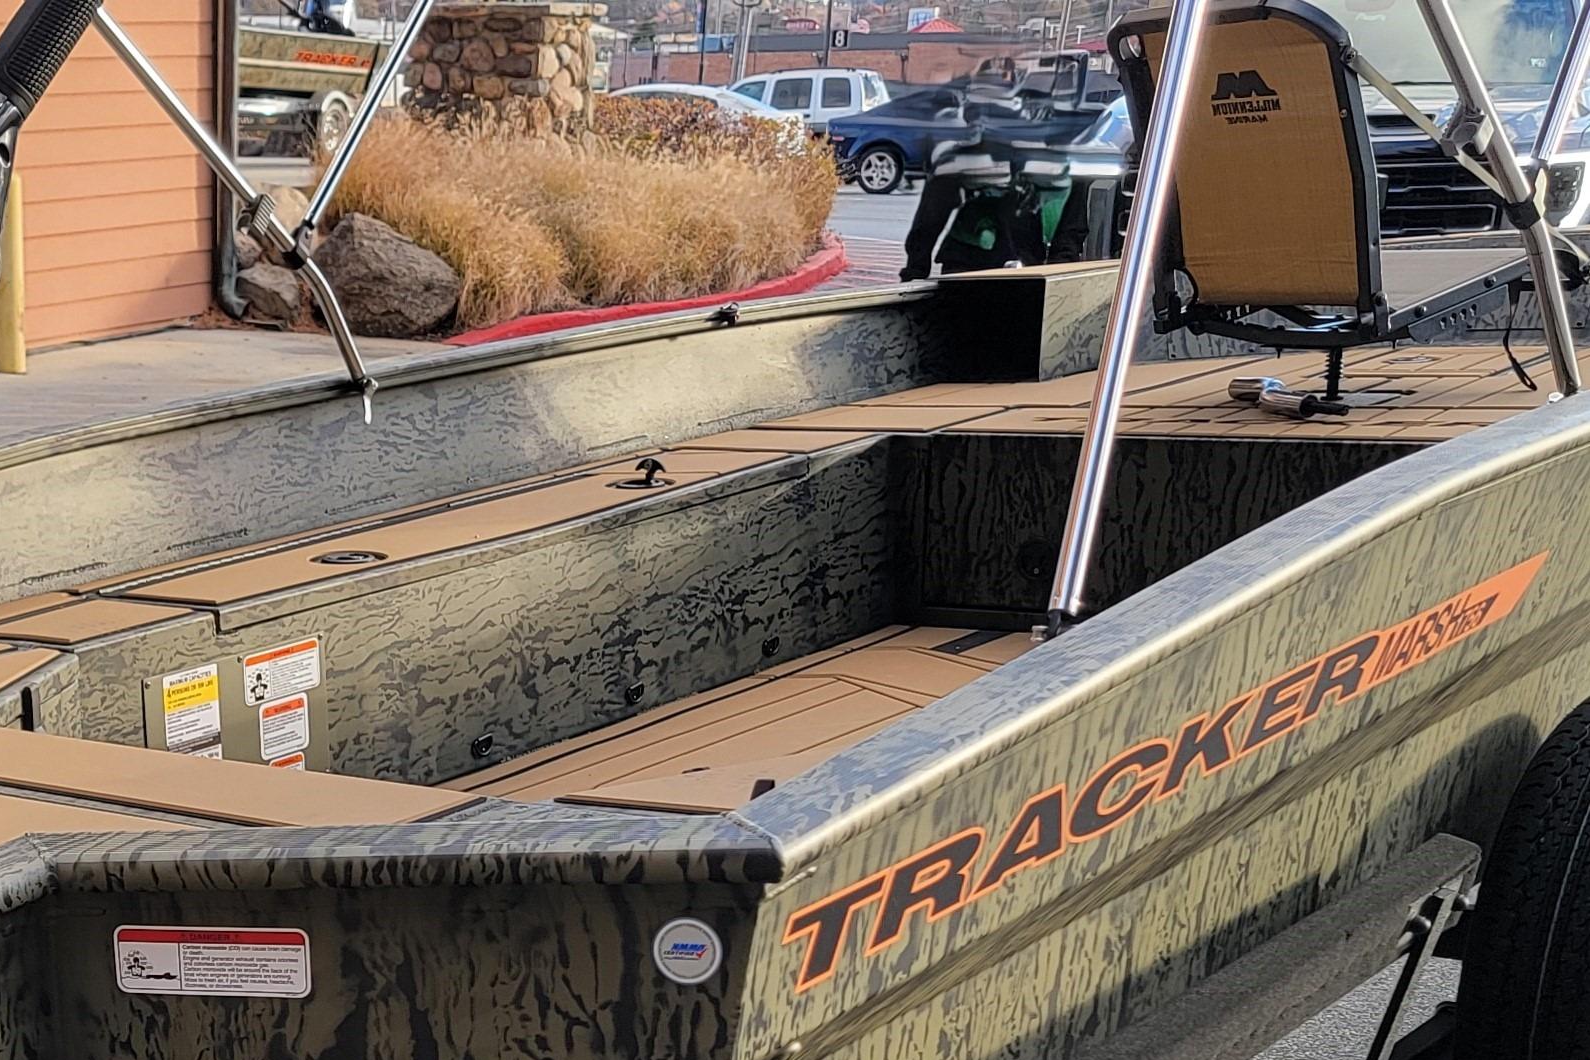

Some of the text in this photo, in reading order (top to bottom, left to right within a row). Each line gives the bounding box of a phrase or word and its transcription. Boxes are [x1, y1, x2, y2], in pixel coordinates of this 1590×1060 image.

[835, 30, 845, 47] 8
[297, 51, 357, 66] TRACKER
[781, 593, 1472, 993] TRACKER MARSH
[188, 933, 230, 942] DANGER
